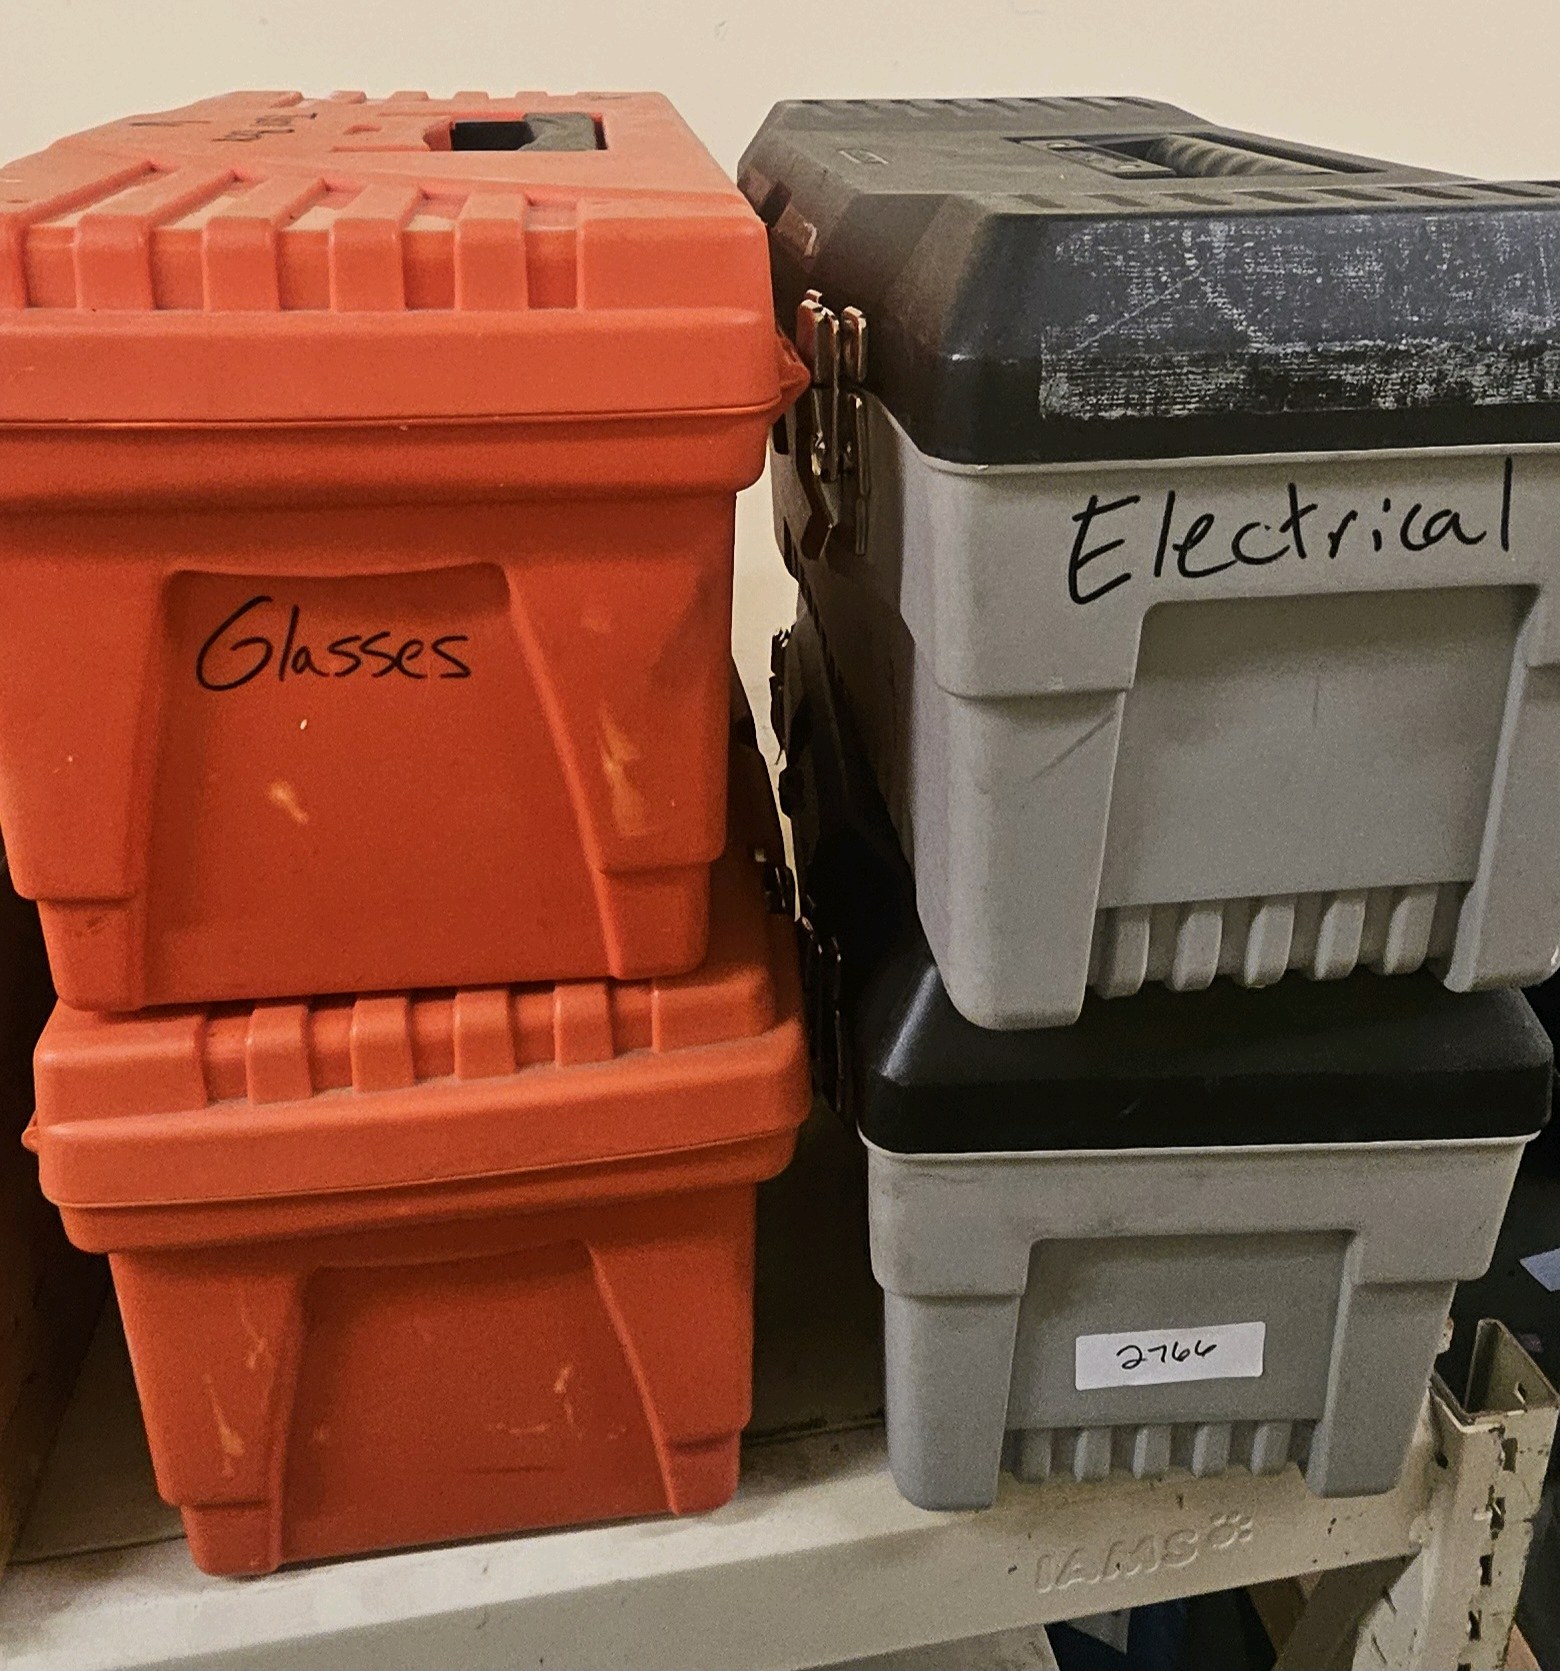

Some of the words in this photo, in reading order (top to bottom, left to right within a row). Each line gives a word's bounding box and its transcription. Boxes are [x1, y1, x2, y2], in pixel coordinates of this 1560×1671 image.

[1069, 457, 1513, 605] Electrical
[196, 595, 472, 692] Glasses
[1116, 1340, 1218, 1370] 2766
